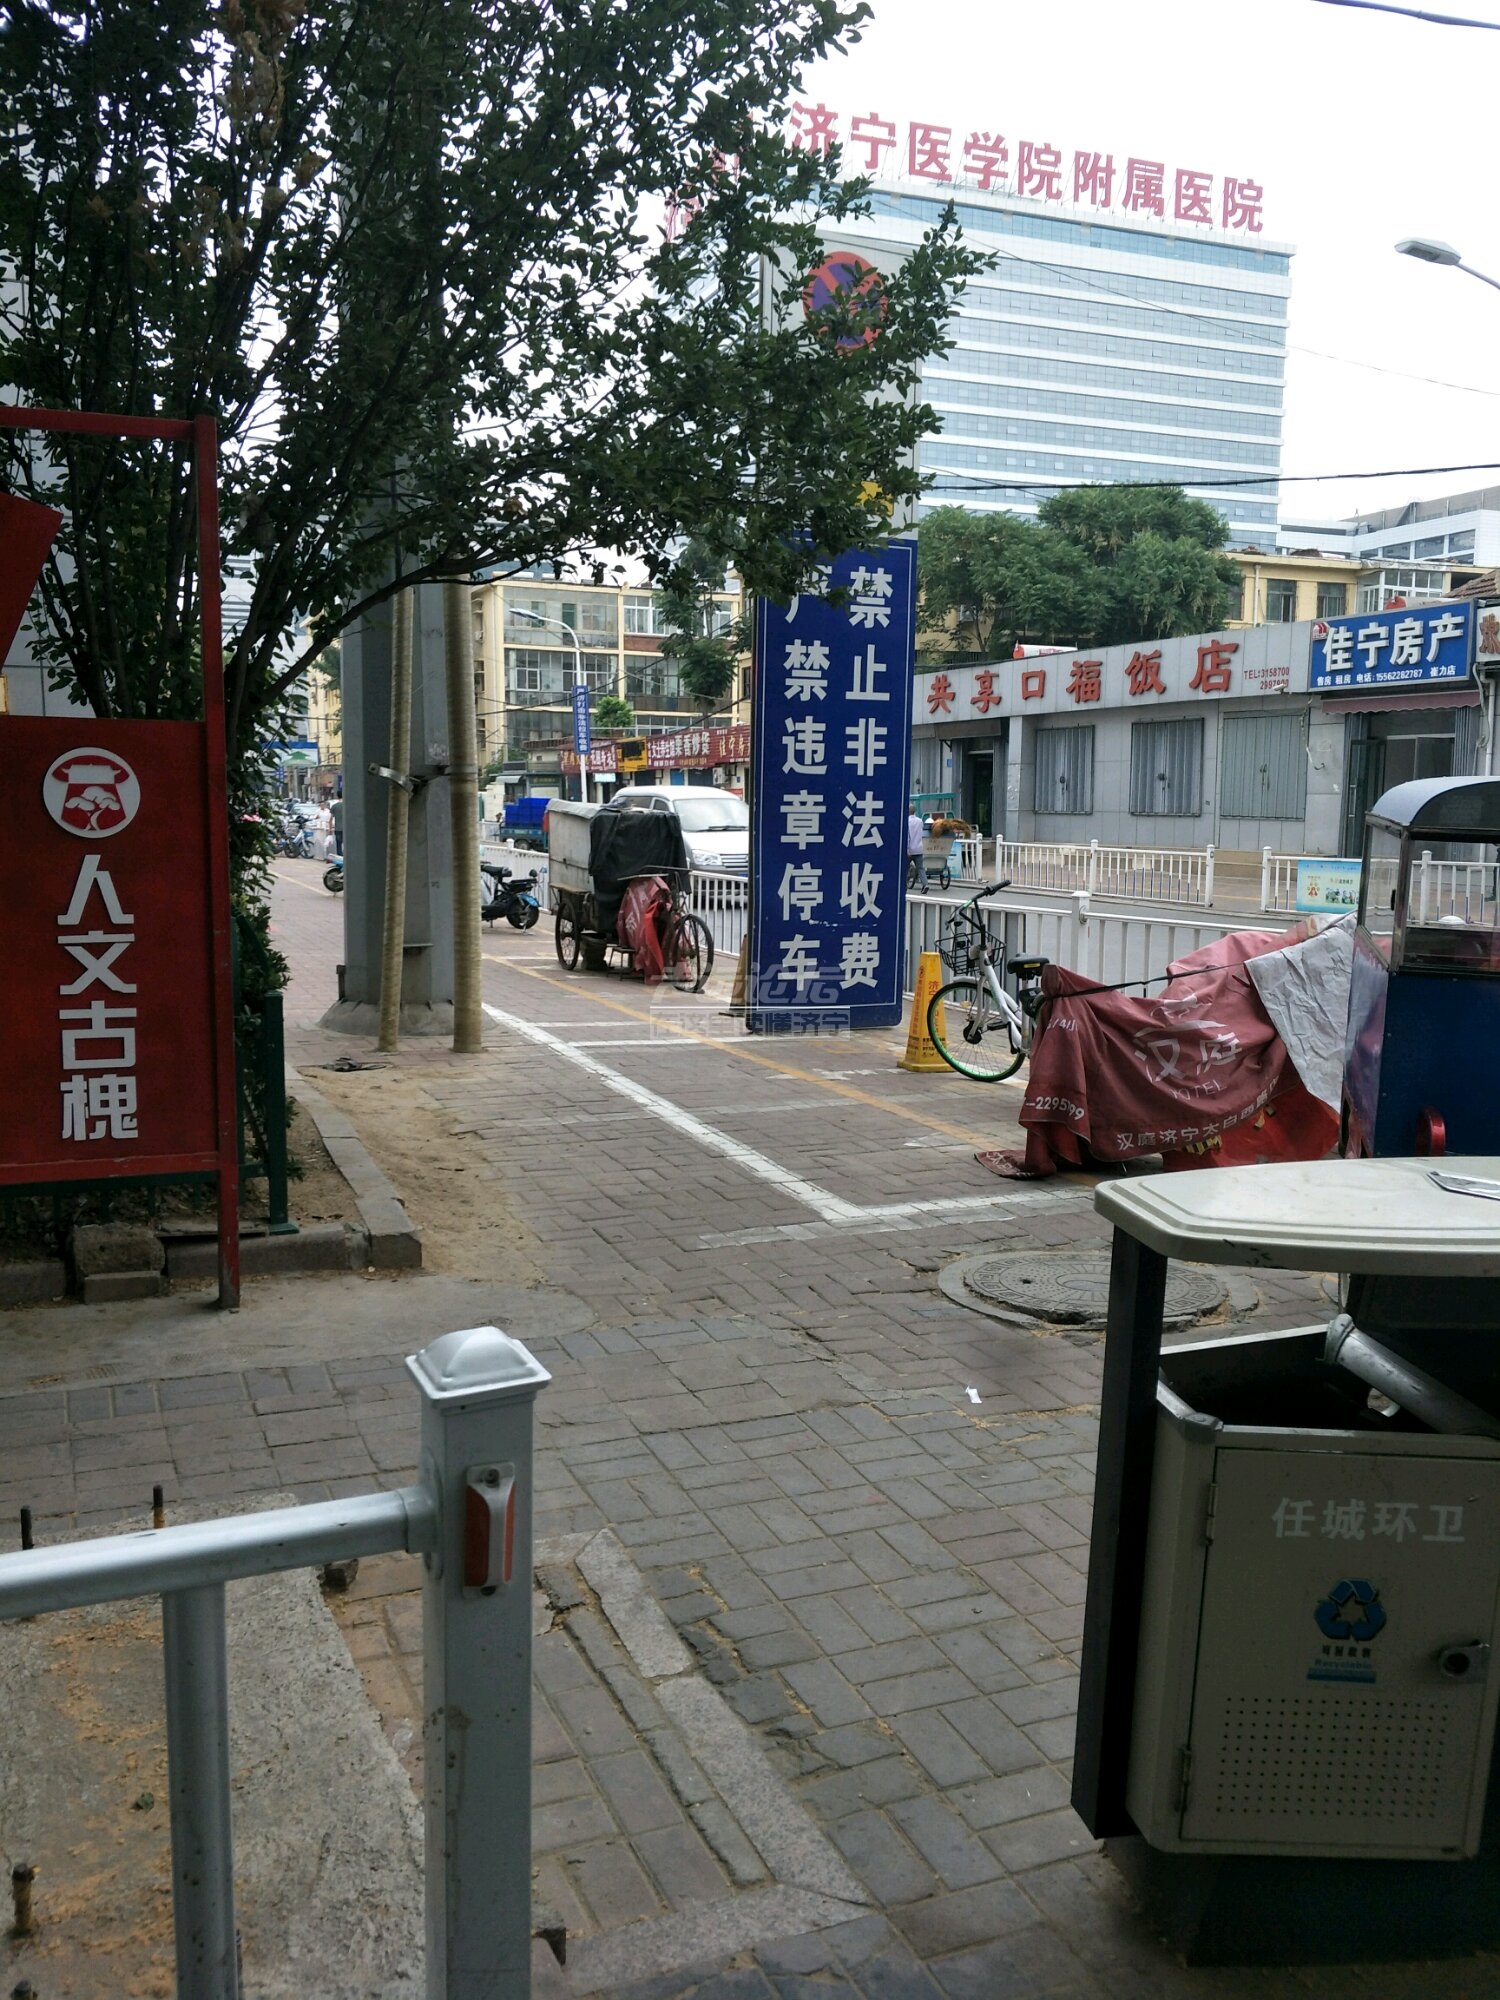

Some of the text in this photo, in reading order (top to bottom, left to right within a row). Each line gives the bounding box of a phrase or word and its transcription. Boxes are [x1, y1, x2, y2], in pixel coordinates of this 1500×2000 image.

[787, 100, 1266, 234] 济宁医学院附属医院
[926, 639, 1239, 714] 共享口福饭店
[1322, 612, 1466, 672] 佳宁房产
[839, 566, 894, 991] 禁止非法收费
[56, 853, 138, 1141] 人文古槐
[1271, 1497, 1466, 1543] 任城环卫
